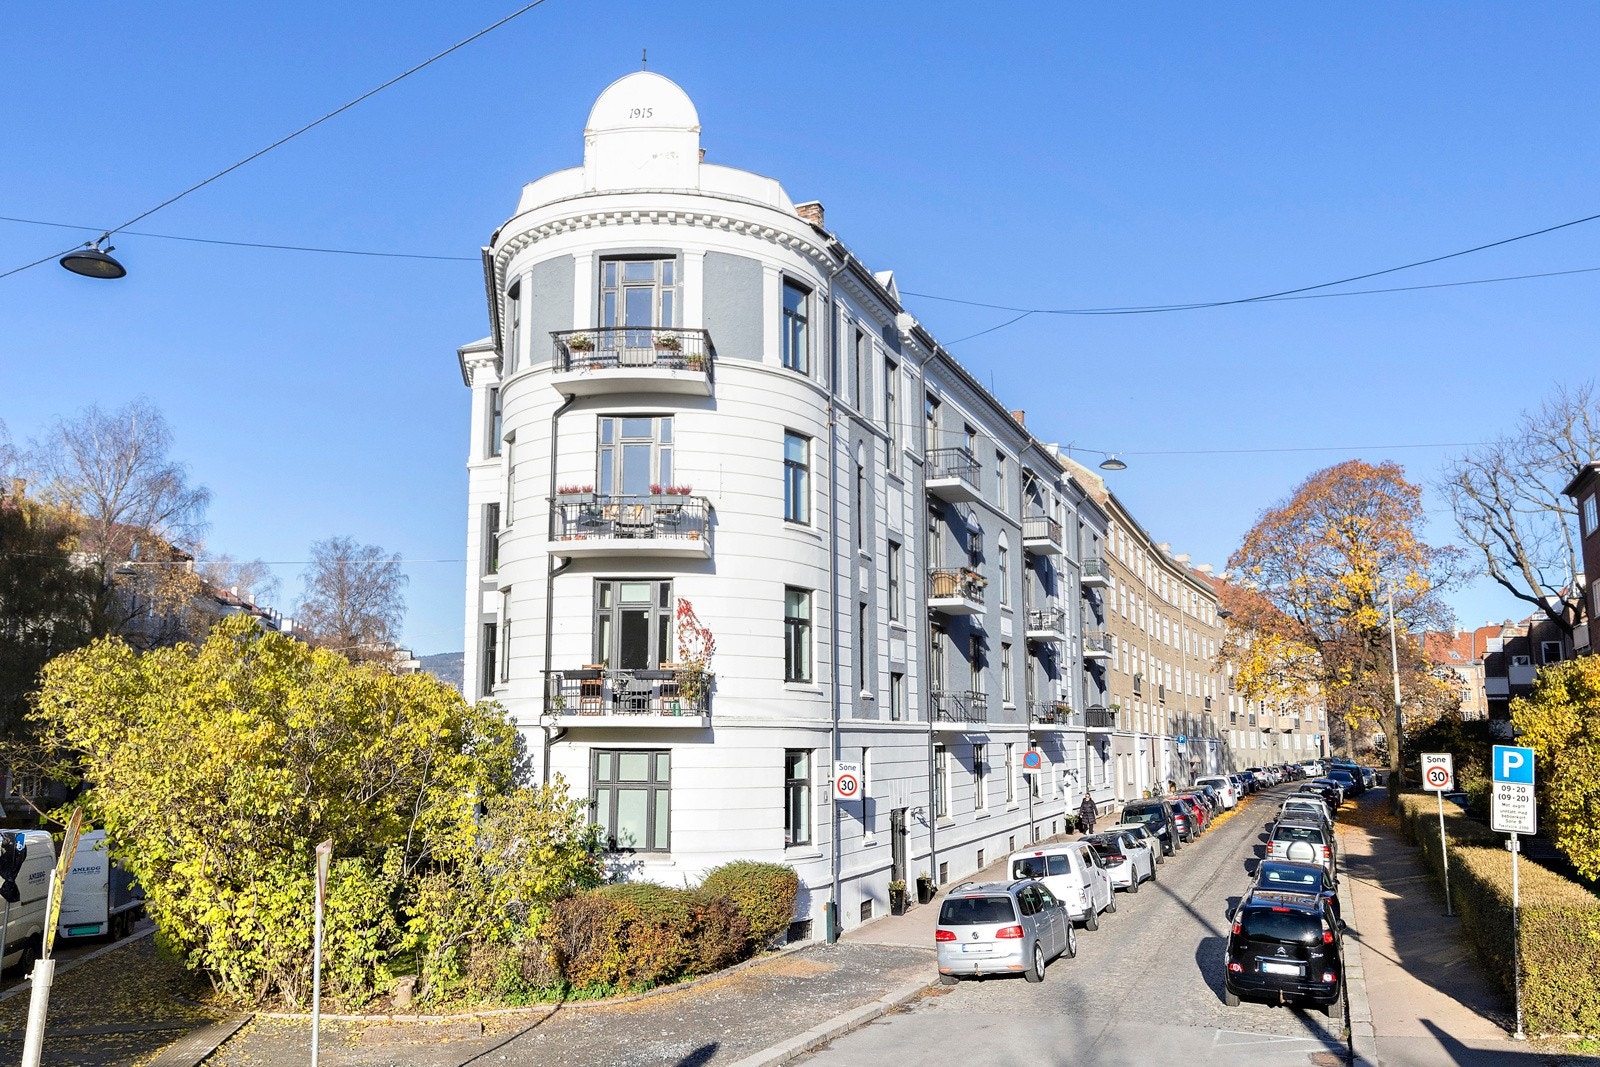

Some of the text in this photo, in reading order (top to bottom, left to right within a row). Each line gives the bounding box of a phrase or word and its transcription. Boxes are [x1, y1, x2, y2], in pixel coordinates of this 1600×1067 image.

[629, 107, 653, 119] 1915
[1426, 755, 1447, 763] Sone
[1503, 750, 1525, 778] P
[838, 763, 857, 771] Sone
[1430, 771, 1445, 782] 30
[841, 779, 854, 791] 30
